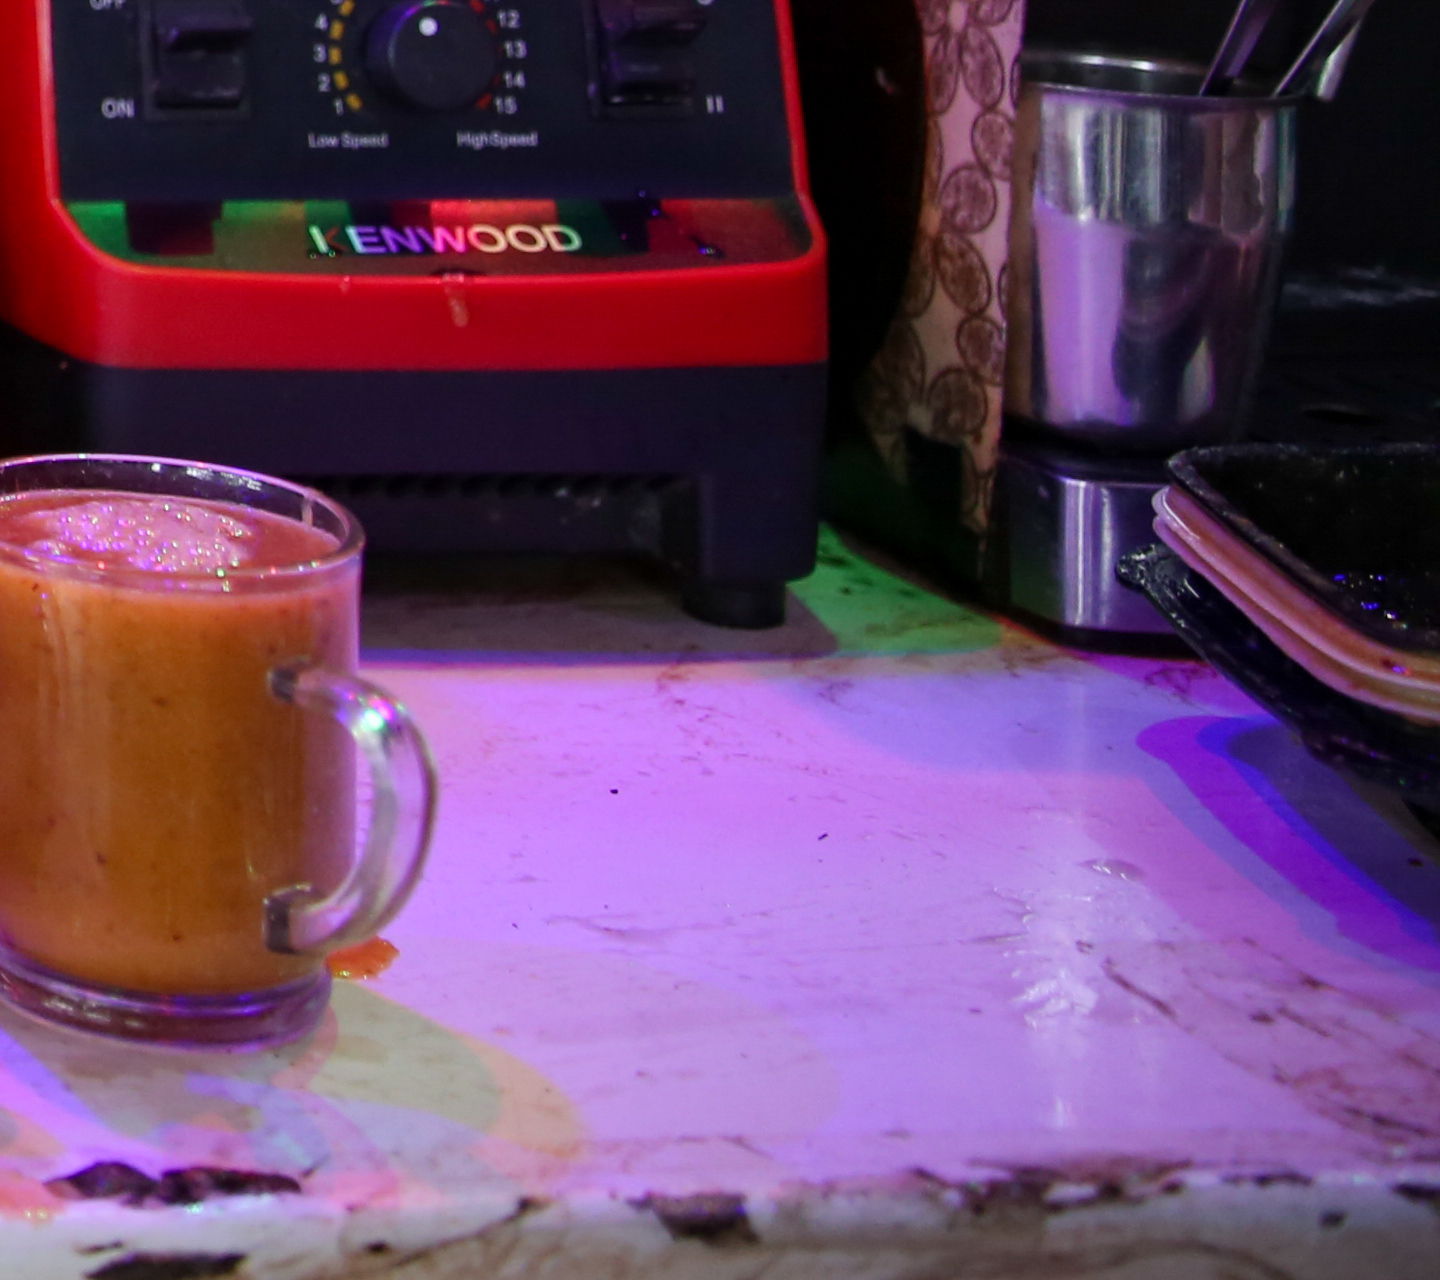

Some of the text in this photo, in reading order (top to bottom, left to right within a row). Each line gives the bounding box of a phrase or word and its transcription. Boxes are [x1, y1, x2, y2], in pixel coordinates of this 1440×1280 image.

[314, 13, 329, 31] 4
[497, 9, 520, 29] 12
[313, 43, 327, 62] 3
[504, 39, 527, 59] 13
[317, 72, 331, 92] 2
[504, 71, 526, 89] 14
[101, 98, 134, 119] ON
[334, 97, 344, 115] 1
[494, 95, 518, 115] 15
[308, 131, 389, 150] Low Speed
[309, 224, 582, 253] KENWOOD
